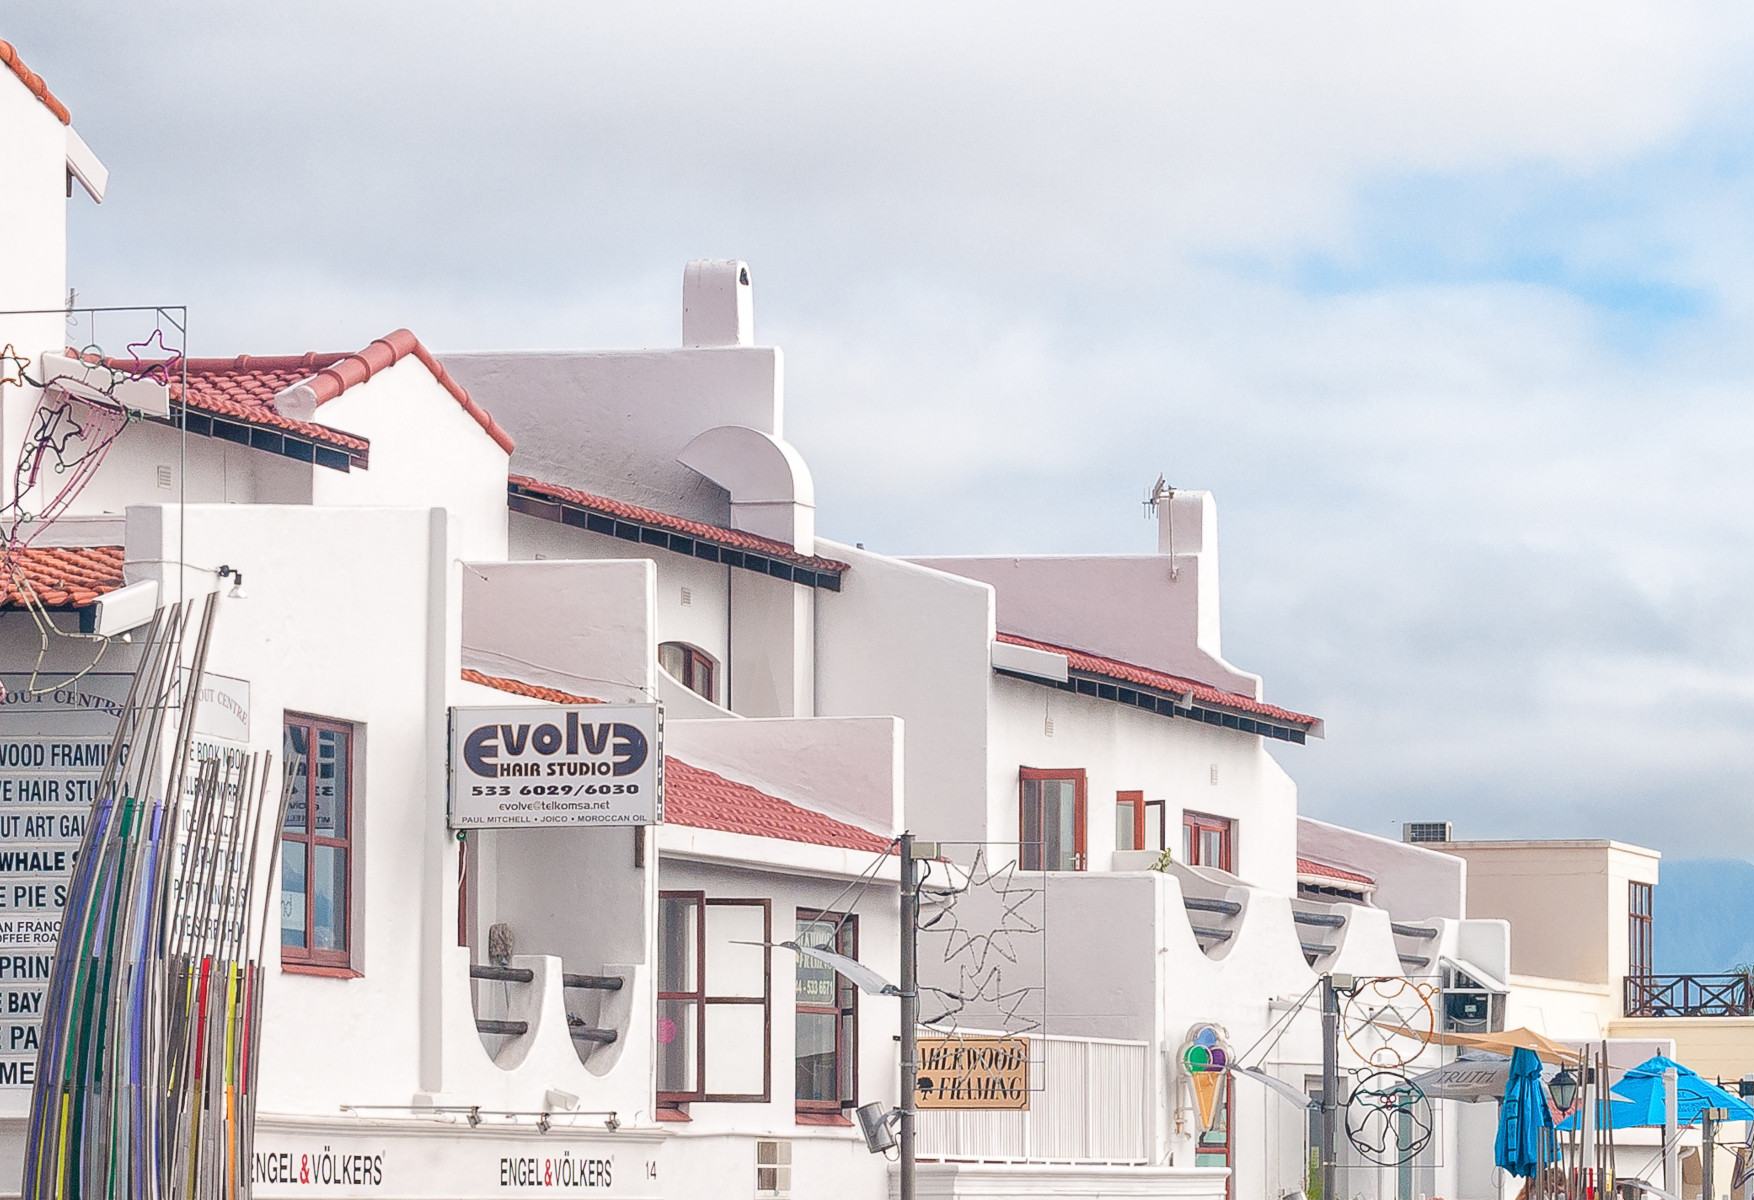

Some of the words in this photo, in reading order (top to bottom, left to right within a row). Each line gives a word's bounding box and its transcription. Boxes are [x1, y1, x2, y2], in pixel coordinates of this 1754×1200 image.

[1, 689, 43, 704] OUT
[51, 744, 130, 767] FRAMIG
[500, 763, 541, 777] HAIR
[546, 761, 611, 777] STUDIO
[18, 780, 62, 802] HAIR
[471, 785, 511, 796] 533
[519, 784, 639, 797] 6029/6030
[499, 800, 610, 812] evolve@telkomsa.net
[24, 816, 56, 837] ART
[462, 816, 483, 824] PAUL
[487, 816, 531, 824] MITCHELL
[14, 886, 46, 907] PIE
[8, 992, 42, 1013] BAY
[939, 1077, 1022, 1100] FRAMING
[645, 1160, 657, 1180] 14
